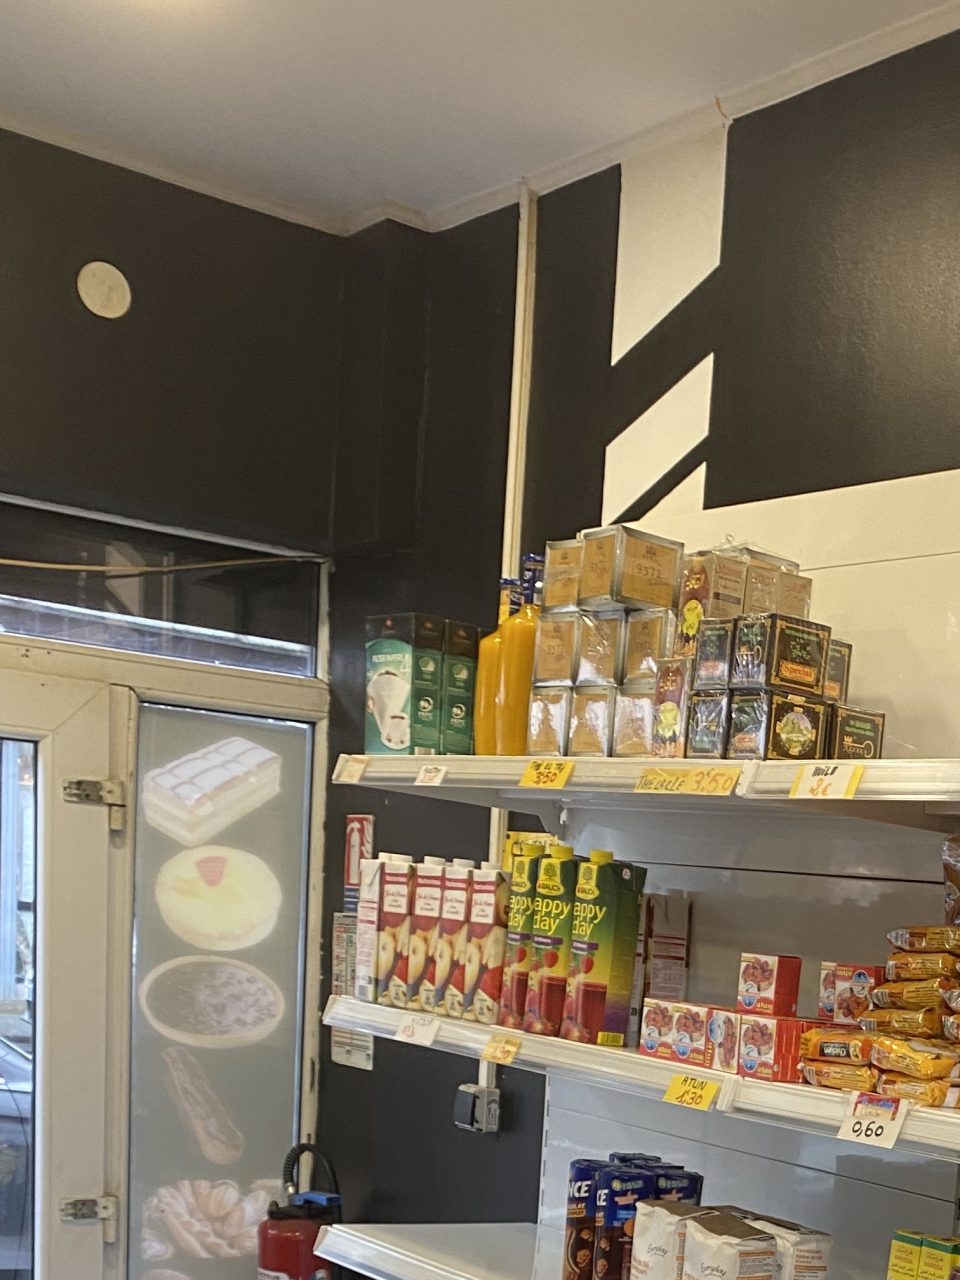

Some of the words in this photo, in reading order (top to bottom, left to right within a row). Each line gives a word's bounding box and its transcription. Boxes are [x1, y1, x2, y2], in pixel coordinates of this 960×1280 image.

[534, 897, 572, 919] appy
[573, 902, 607, 924] appy
[681, 1076, 708, 1091] ATUN
[852, 1121, 884, 1138] 0,60
